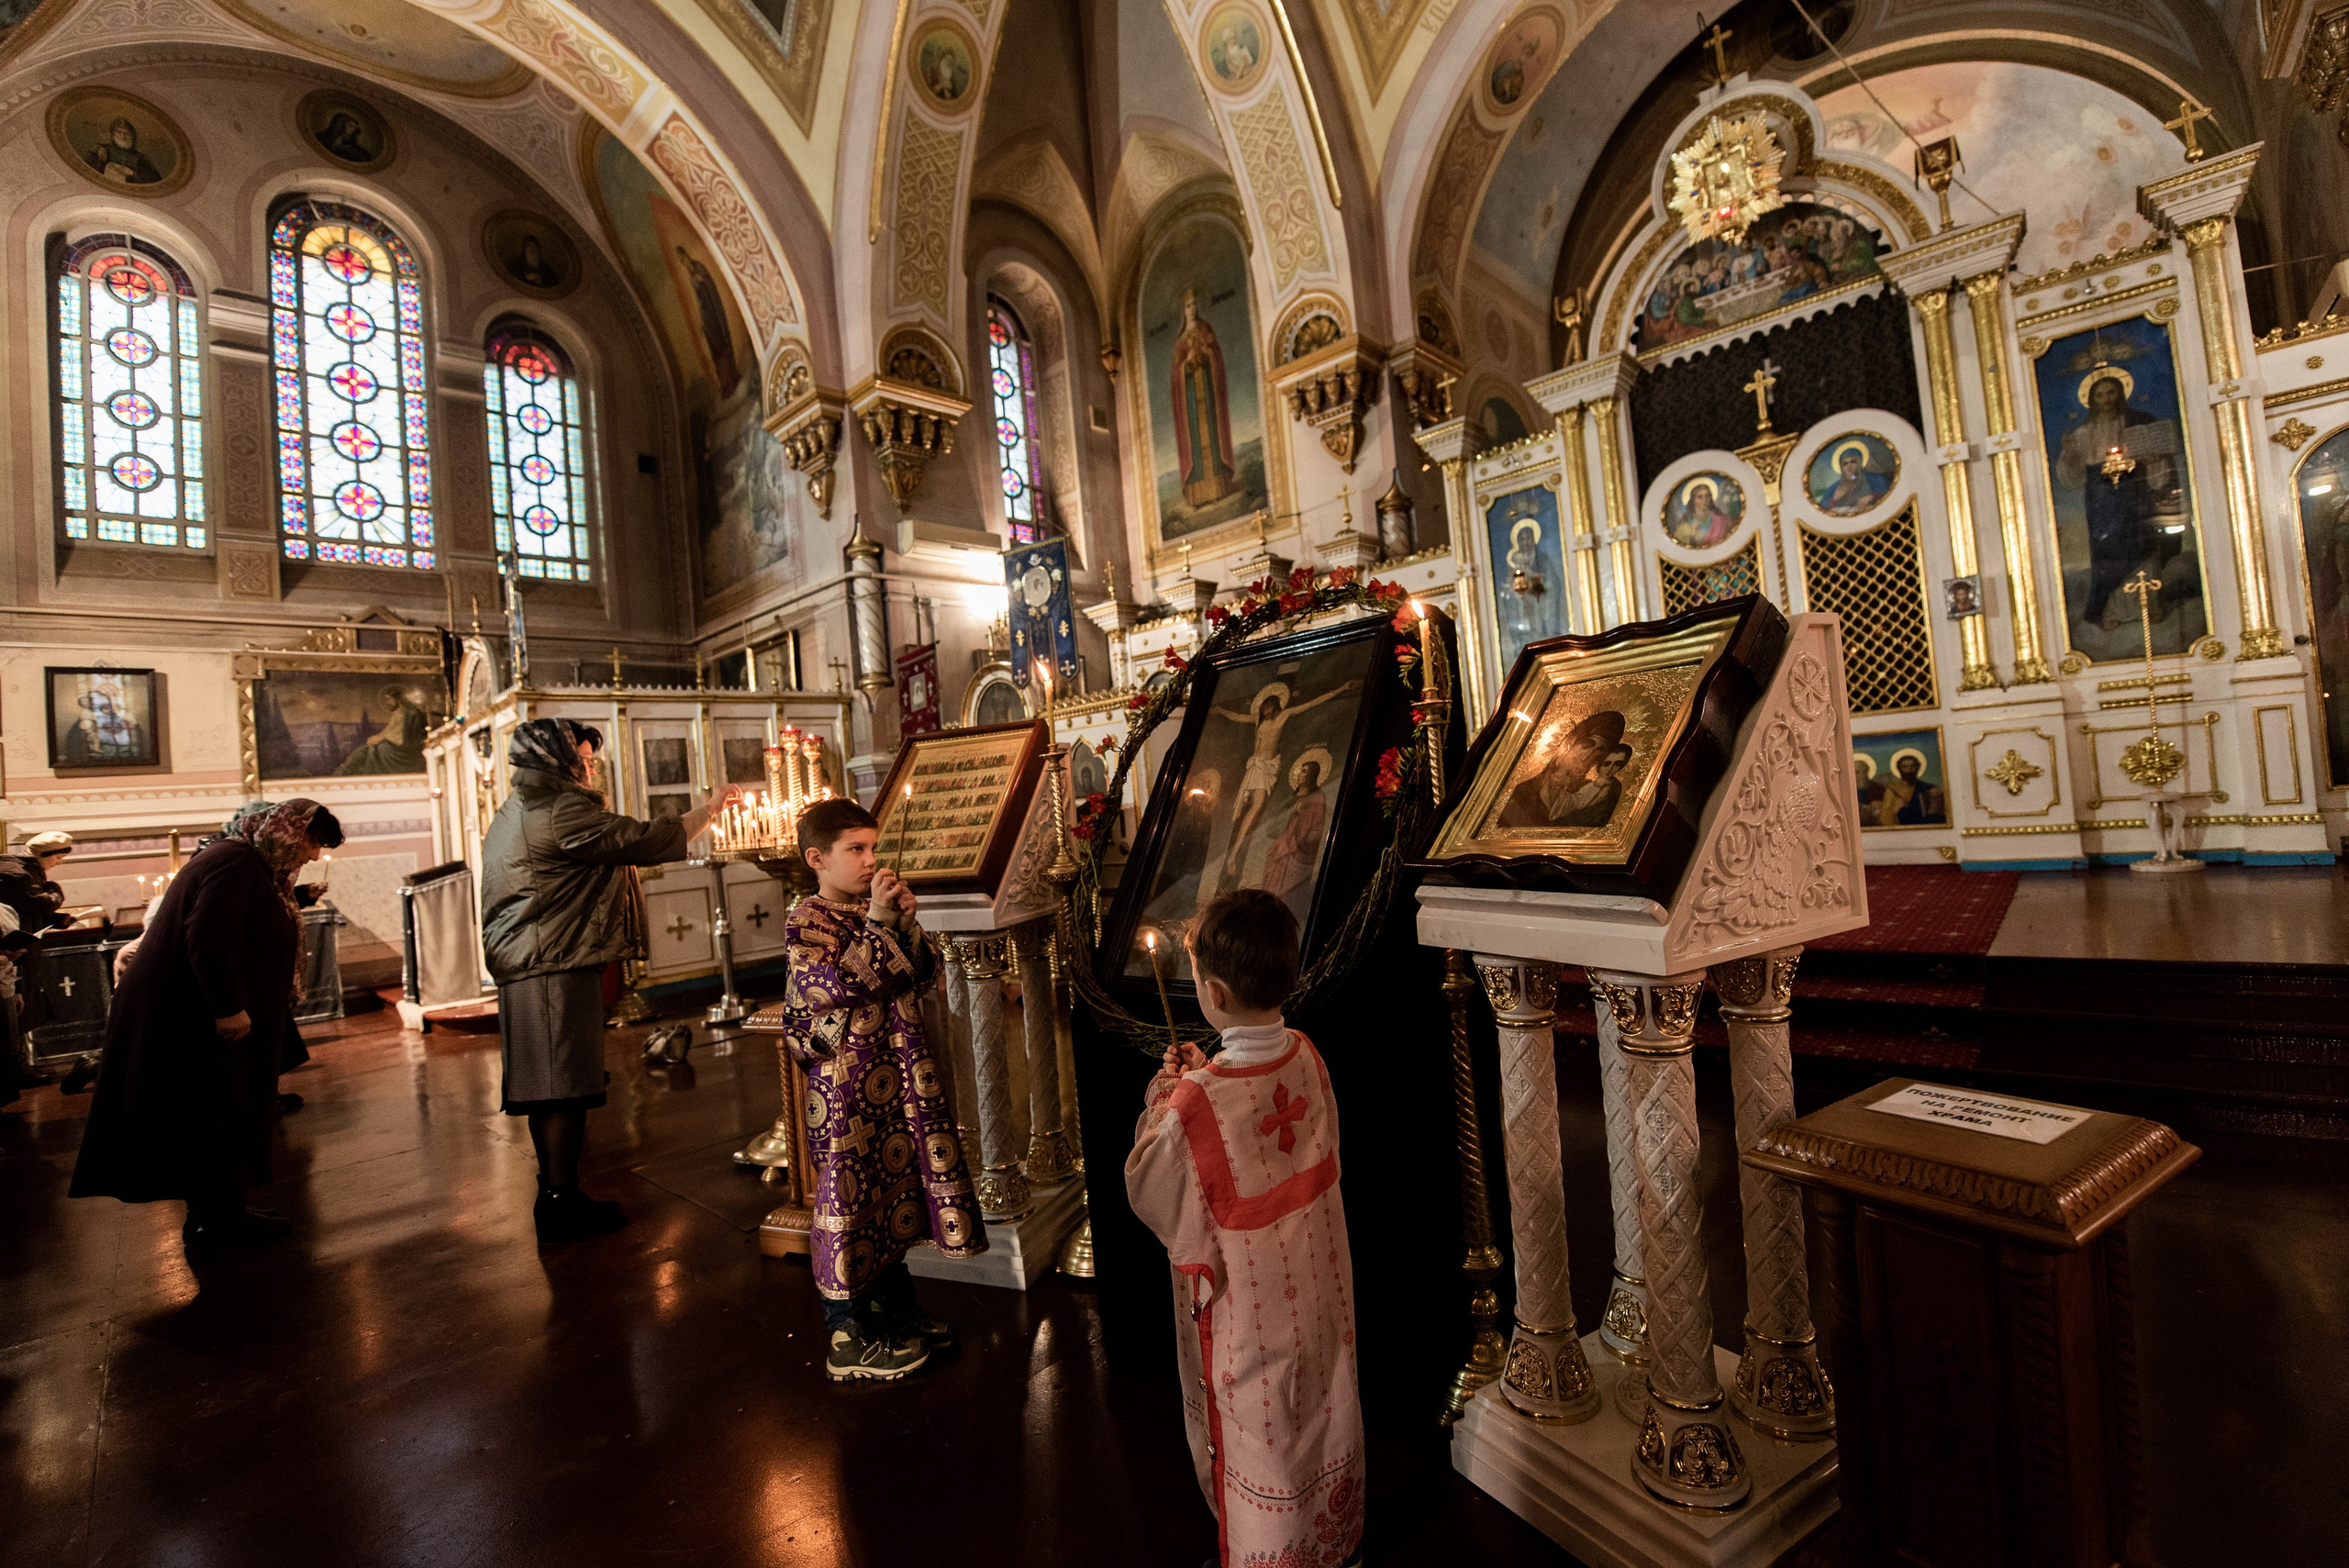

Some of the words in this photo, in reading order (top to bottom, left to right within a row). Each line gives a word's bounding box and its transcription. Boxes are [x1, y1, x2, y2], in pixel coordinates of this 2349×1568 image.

[1906, 1088, 2076, 1123] ПОЖЕРТВОВАНИЕ
[1920, 1099, 1946, 1109] НА
[1950, 1106, 2032, 1124] РЕМОНТ
[1927, 1110, 1993, 1127] ХРАМА
